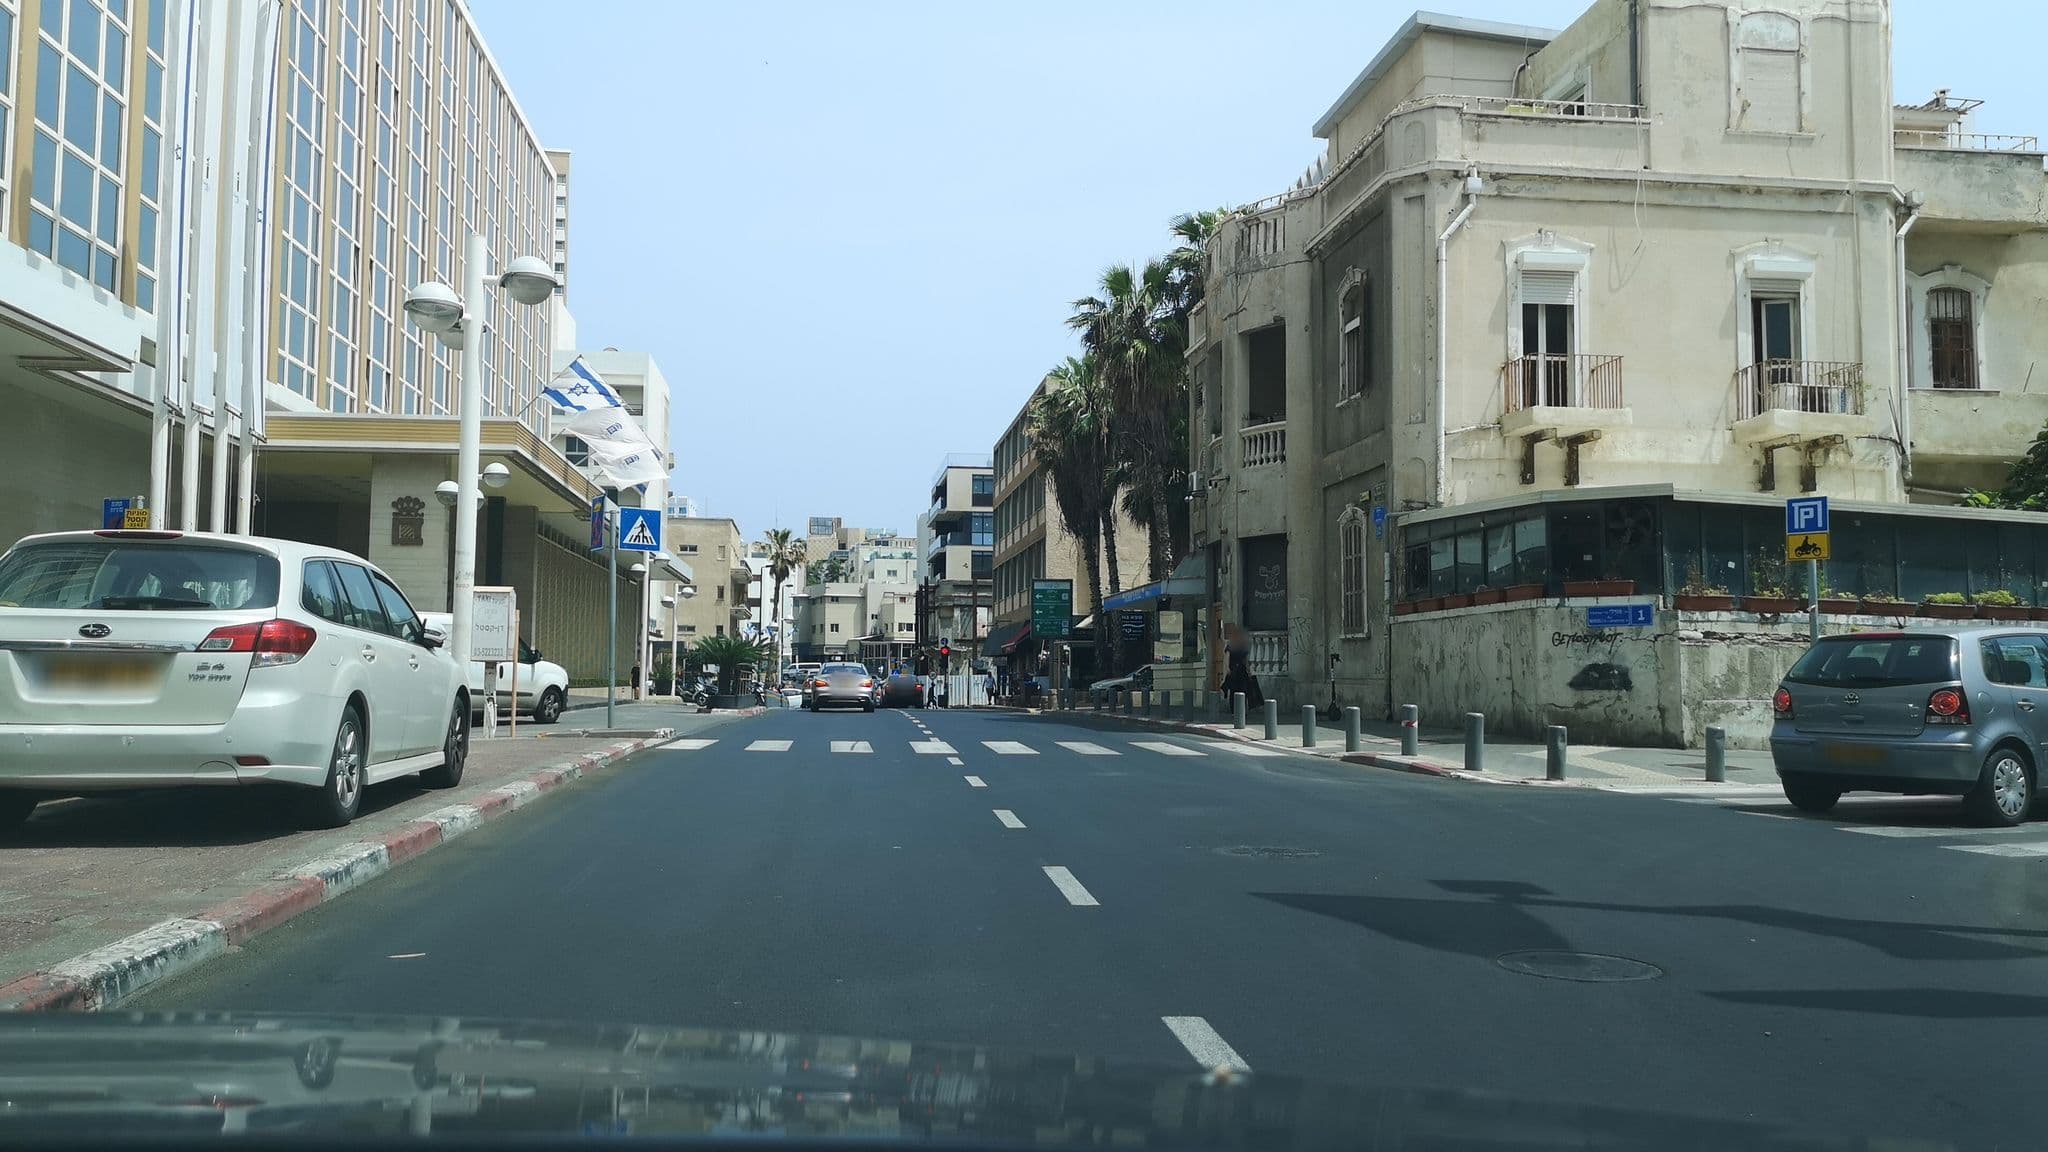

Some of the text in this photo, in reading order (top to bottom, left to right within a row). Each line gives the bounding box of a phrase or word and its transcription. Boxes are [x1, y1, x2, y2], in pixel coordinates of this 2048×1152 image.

[126, 510, 147, 519] מוניות
[127, 517, 147, 526] קסטל
[1637, 609, 1645, 621] 1
[475, 623, 505, 634] דן-קסטל
